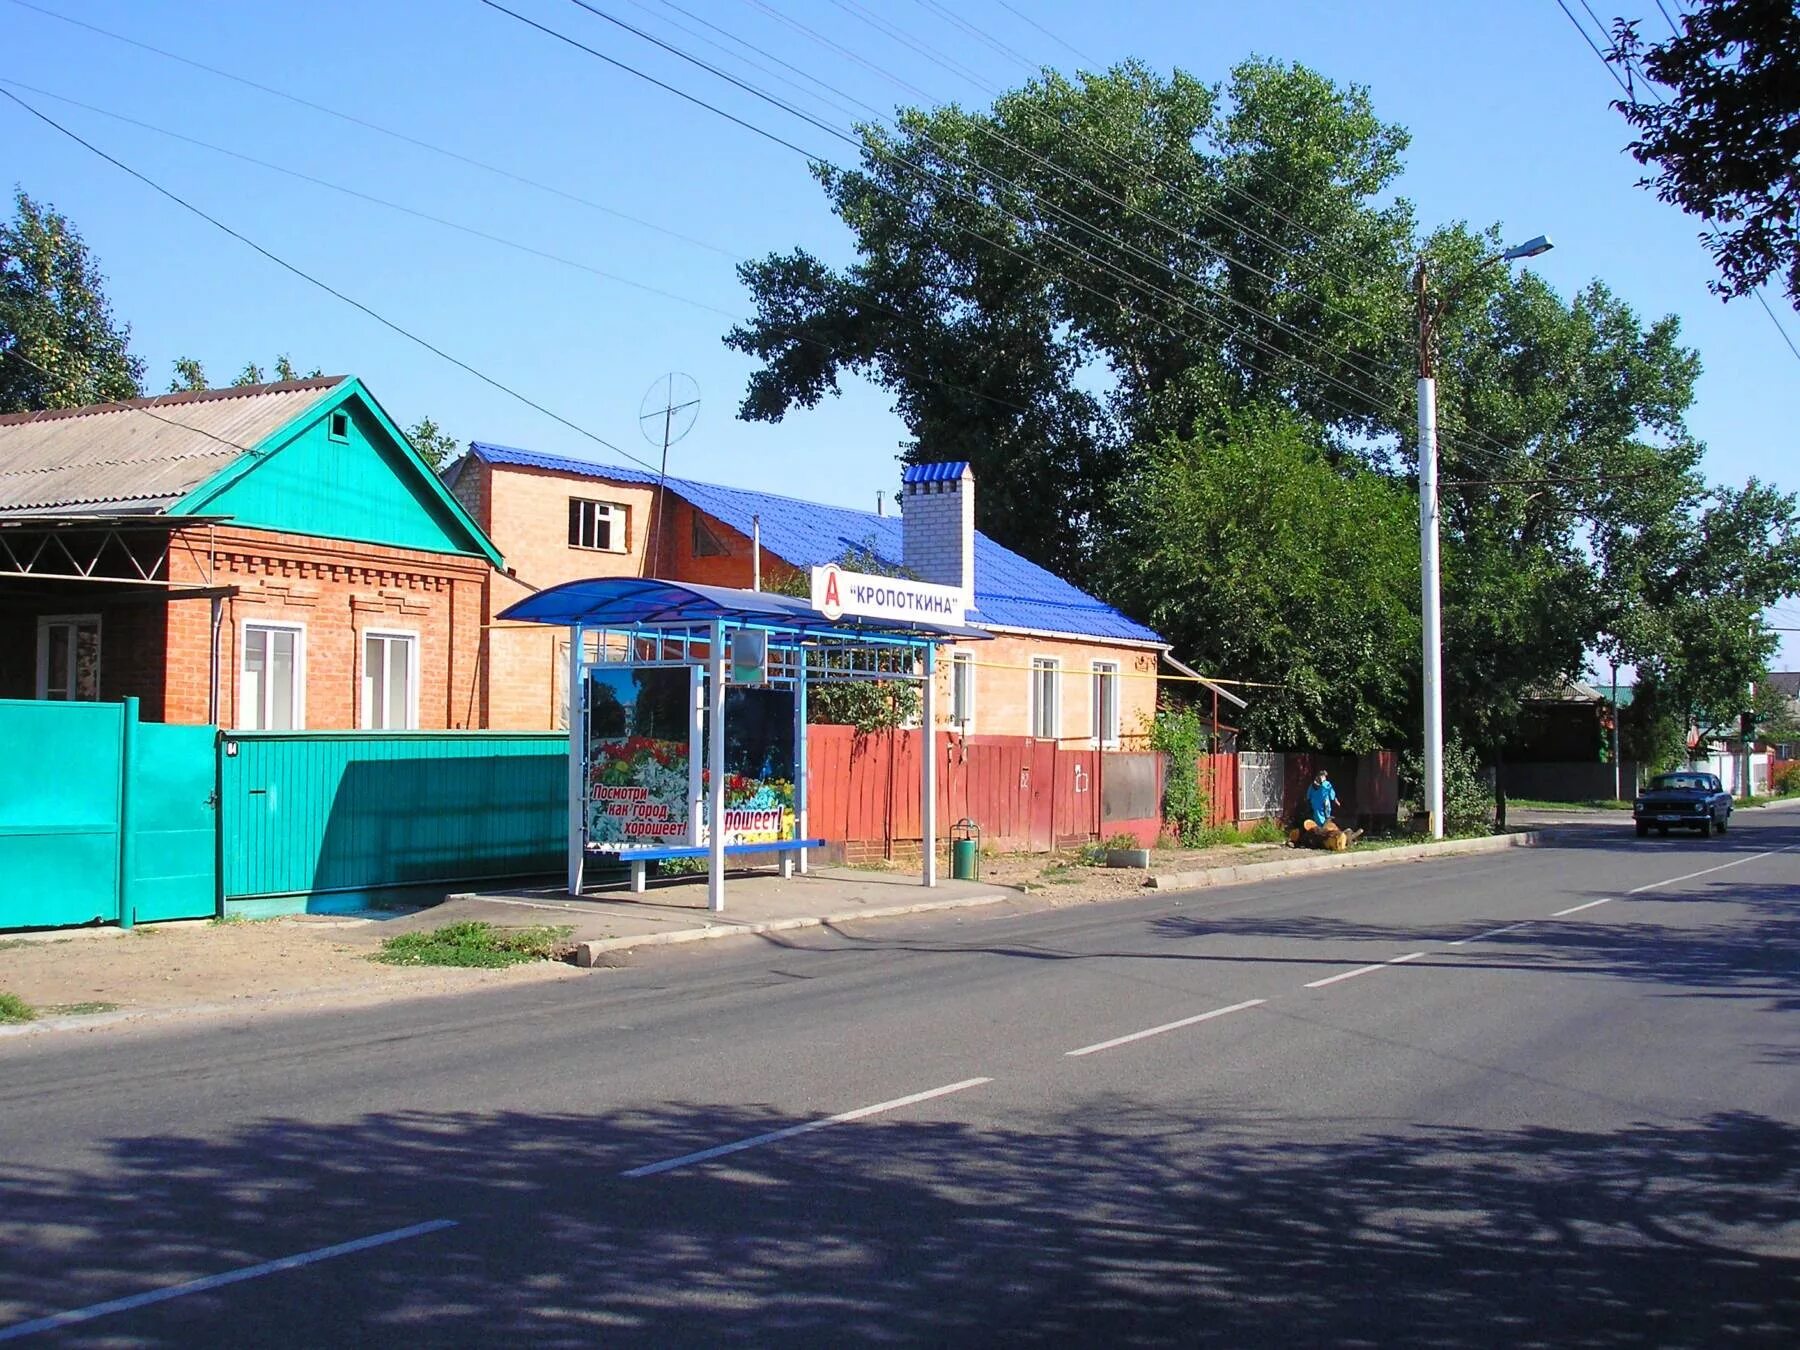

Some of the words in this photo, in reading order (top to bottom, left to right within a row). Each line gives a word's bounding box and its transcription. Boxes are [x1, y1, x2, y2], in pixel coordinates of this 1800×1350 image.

[593, 784, 648, 801] Посмотри
[608, 803, 629, 816] как
[633, 803, 668, 819] город
[724, 806, 783, 834] рошеет!
[624, 821, 688, 837] хорошеет!
